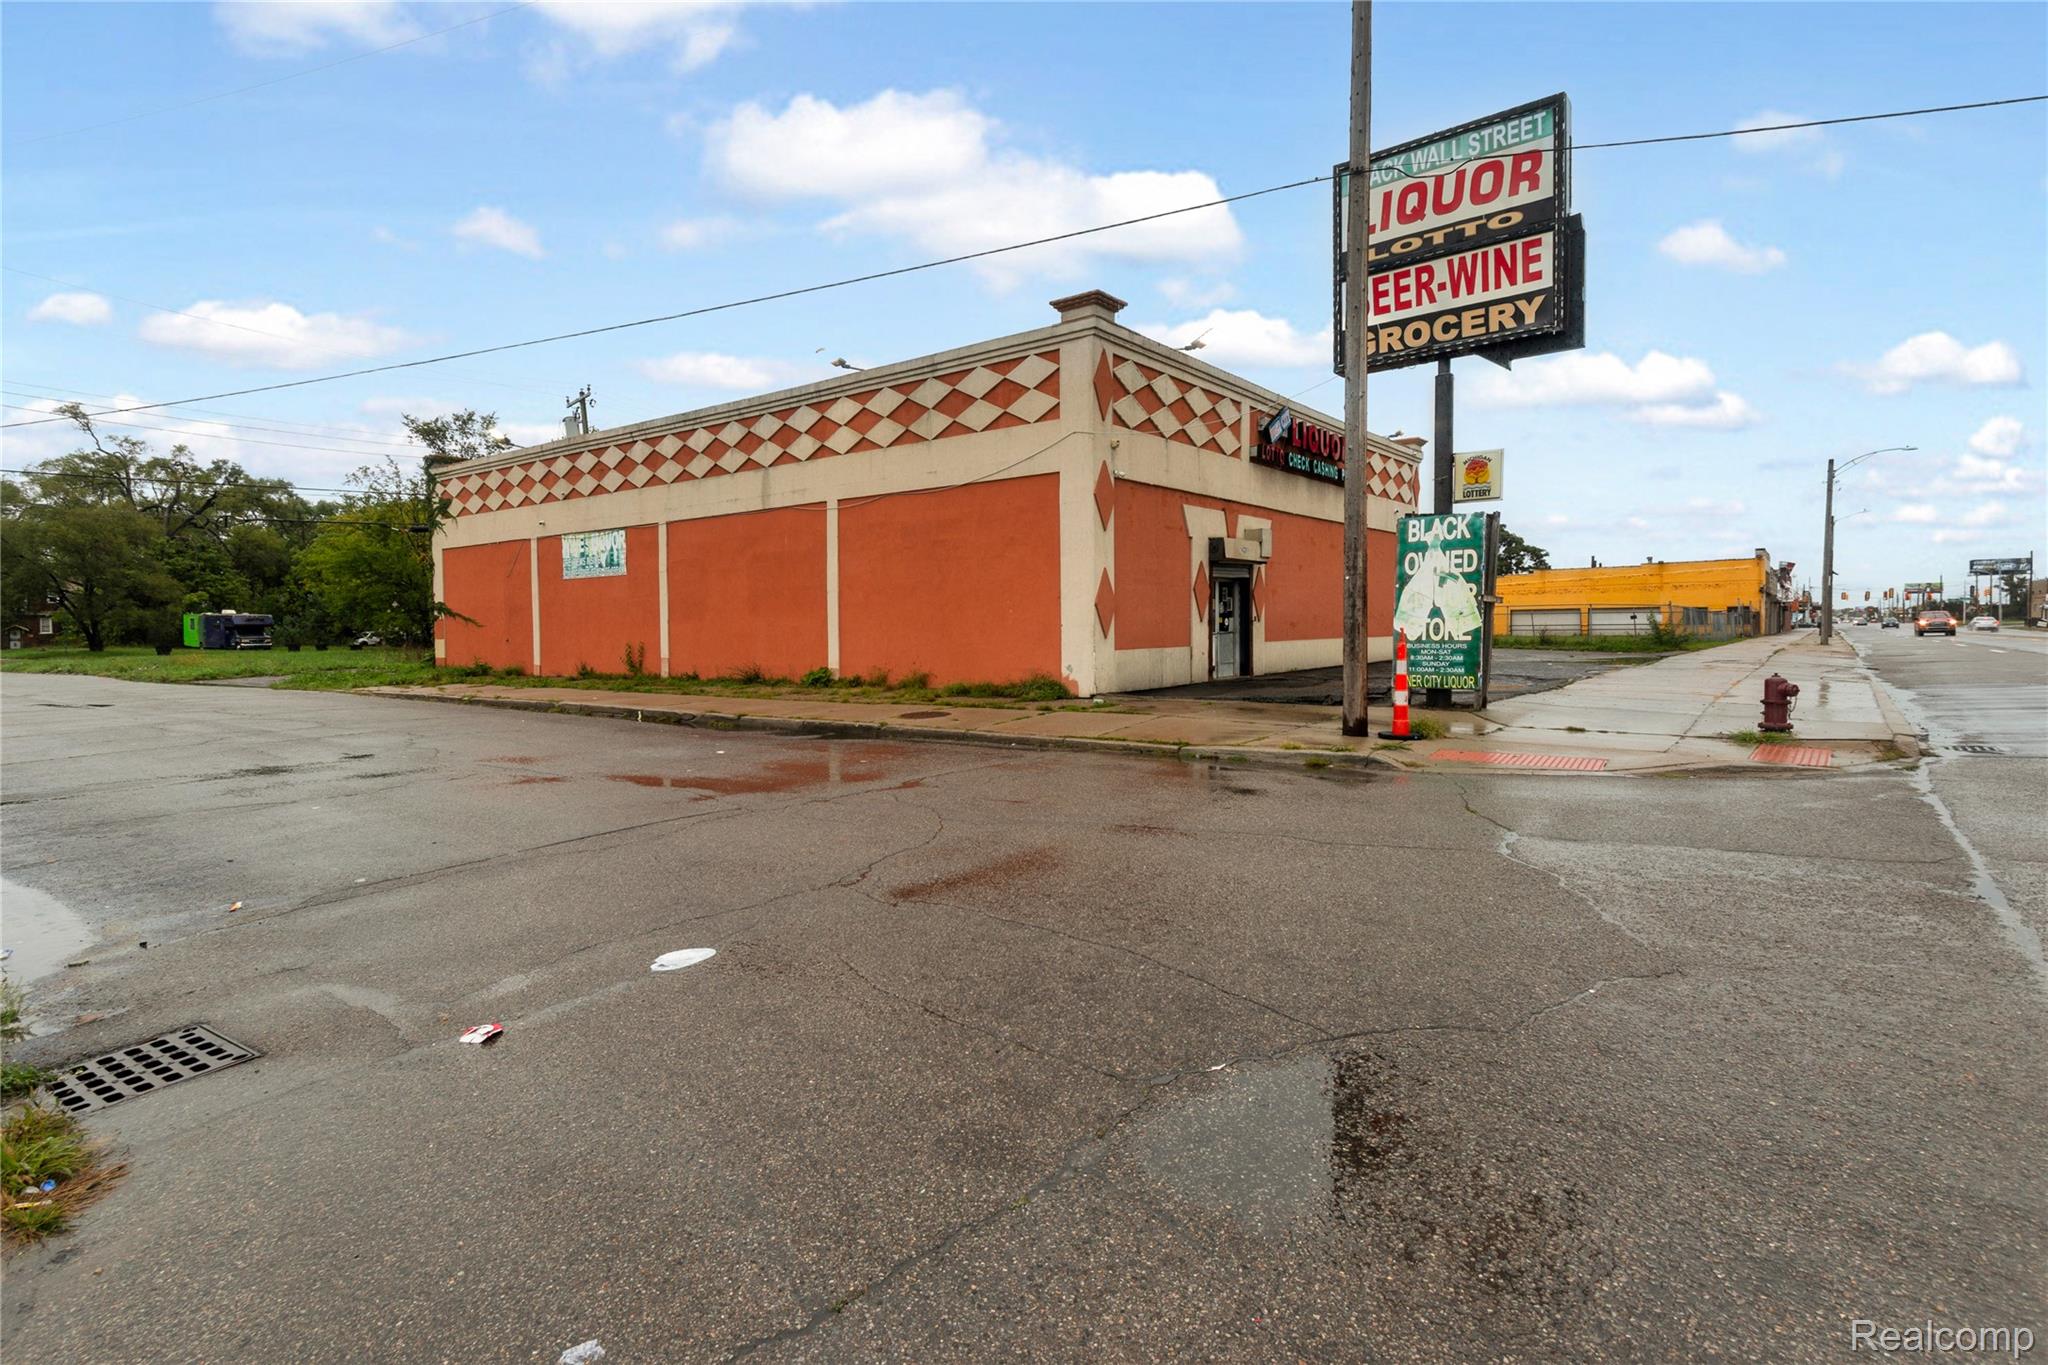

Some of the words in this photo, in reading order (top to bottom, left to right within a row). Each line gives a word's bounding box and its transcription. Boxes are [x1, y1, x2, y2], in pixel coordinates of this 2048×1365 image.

[1370, 156, 1407, 186] ACK
[1411, 140, 1462, 172] WALL
[1467, 112, 1546, 156] STREET
[1367, 149, 1543, 235] IQUOR
[1368, 211, 1523, 261] LOTTO
[1367, 237, 1543, 316] EER-WINE
[1292, 417, 1345, 460] LIQUO
[1288, 452, 1310, 472] CHECK
[1313, 460, 1339, 480] CASHING
[1463, 488, 1491, 498] LOTTERY
[1408, 516, 1471, 543] BLACK
[1405, 549, 1478, 575] OED
[1424, 675, 1442, 688] CITY
[1443, 676, 1475, 689] LIQUOR
